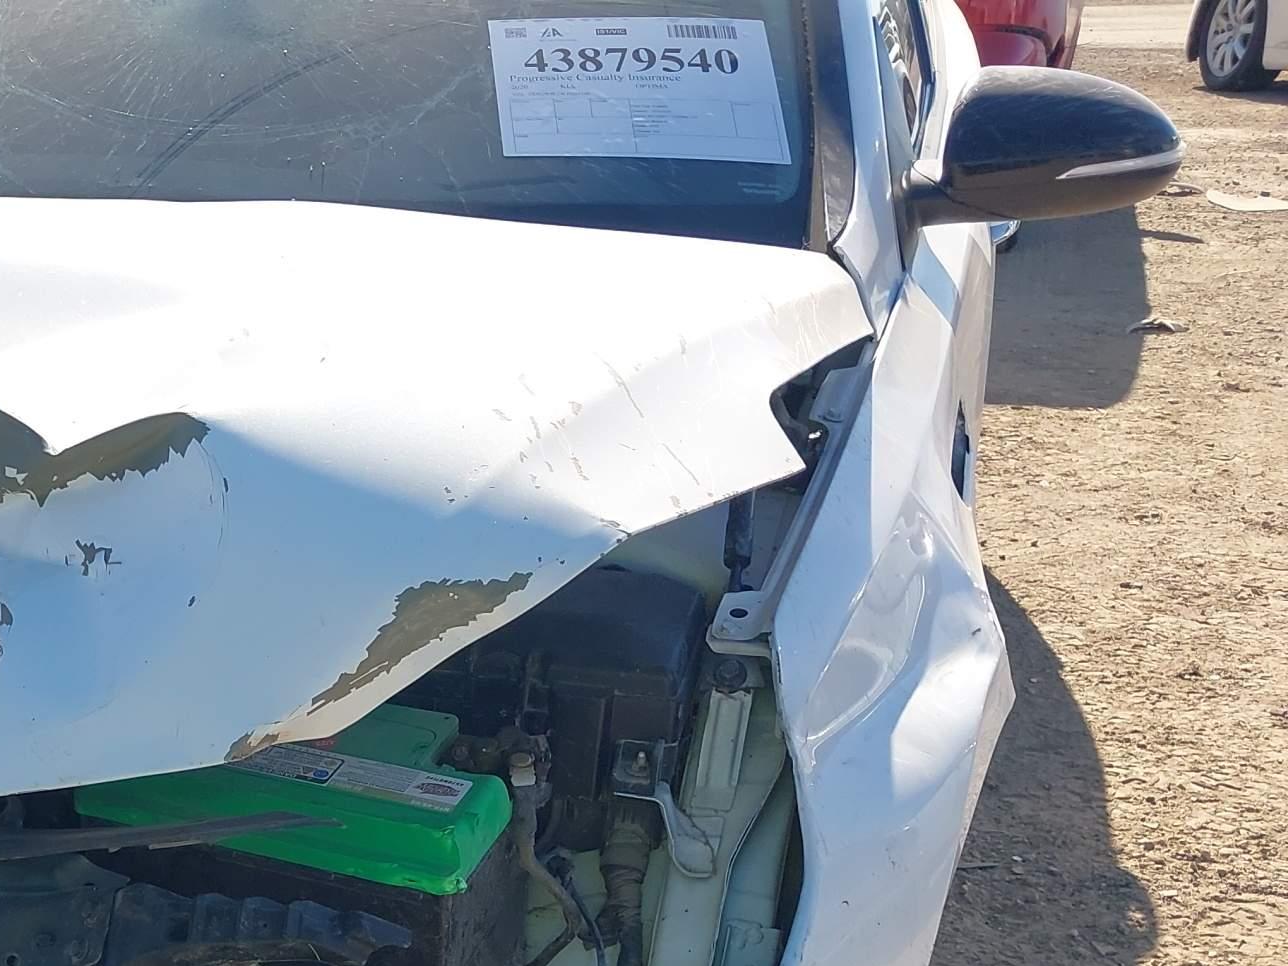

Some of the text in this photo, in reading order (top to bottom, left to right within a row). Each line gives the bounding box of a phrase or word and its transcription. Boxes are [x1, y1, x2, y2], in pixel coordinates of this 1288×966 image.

[524, 47, 740, 74] 43879540
[509, 74, 681, 83] Progressive Casualty Insurance
